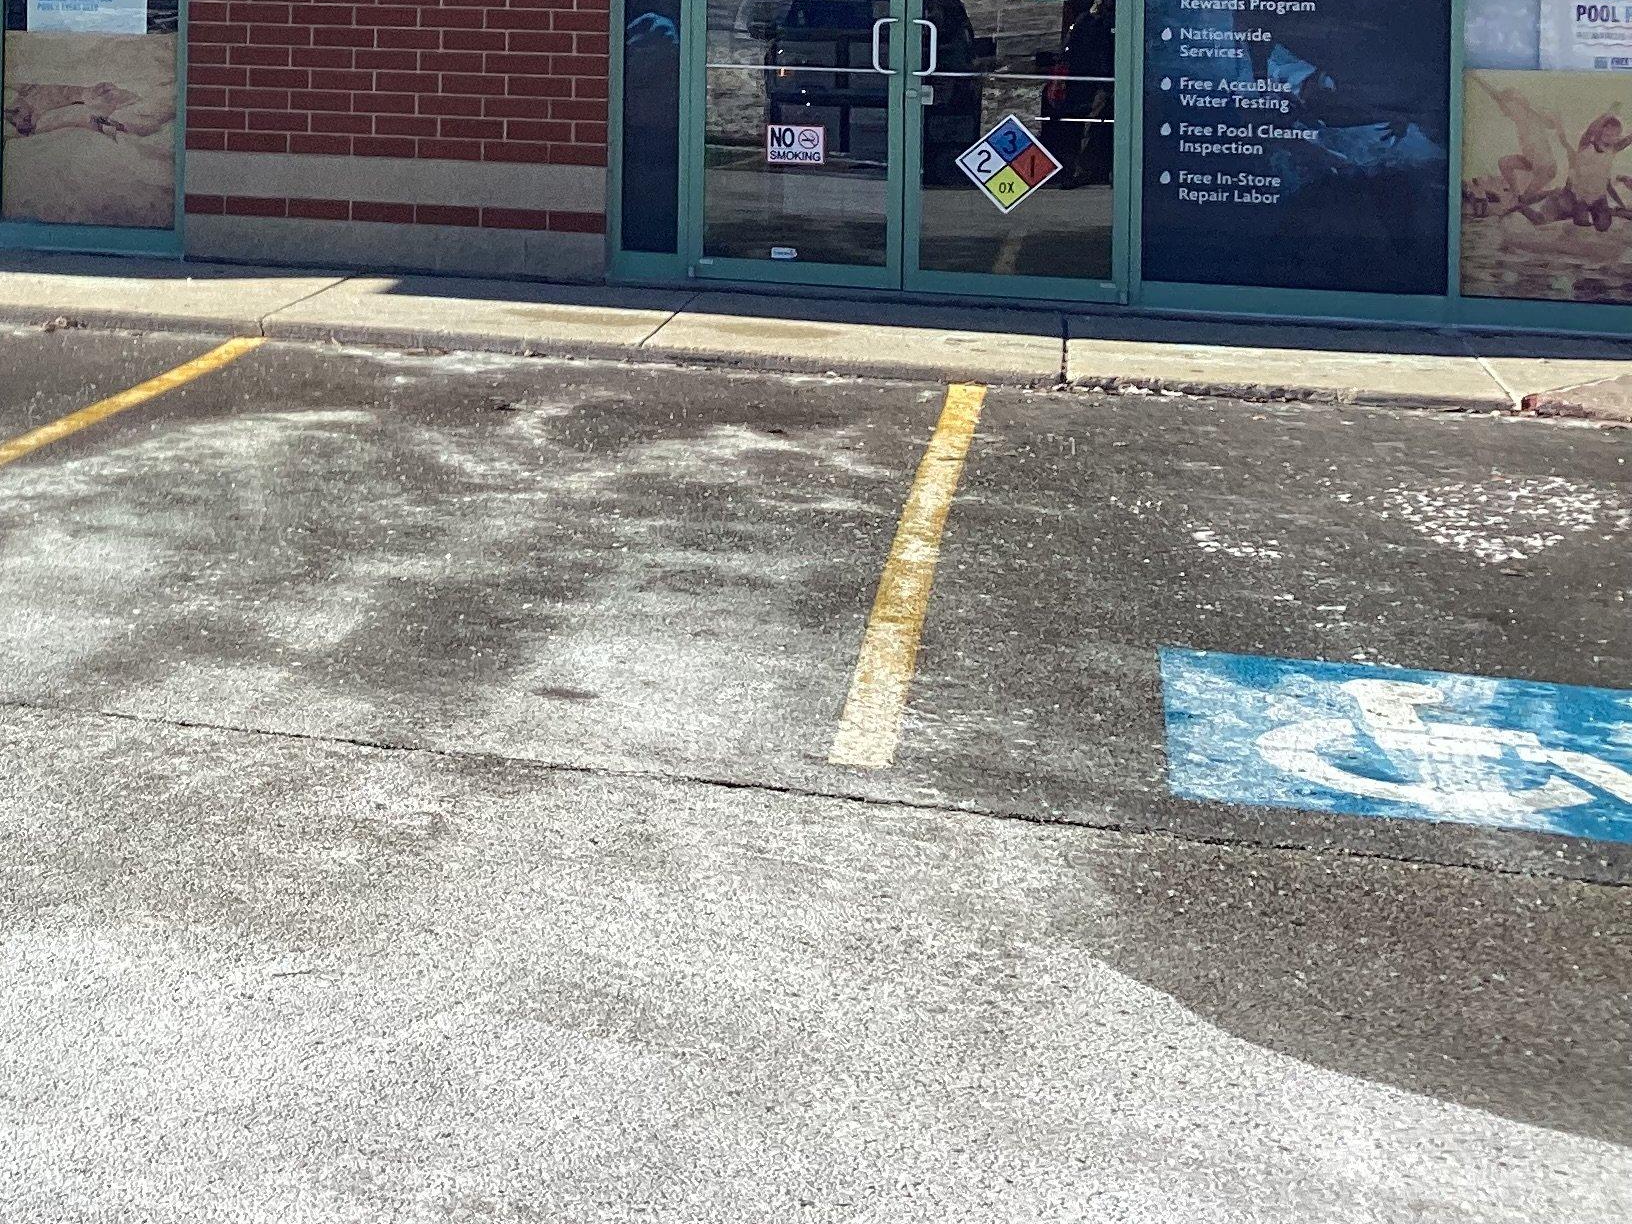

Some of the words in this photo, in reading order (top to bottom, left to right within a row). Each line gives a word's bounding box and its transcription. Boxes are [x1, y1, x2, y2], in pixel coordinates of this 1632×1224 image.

[1576, 4, 1621, 23] POOL
[1180, 27, 1272, 42] Nationwide
[1179, 44, 1245, 58] Services
[1179, 77, 1213, 91] Free
[1217, 78, 1292, 93] AccuBlue
[1179, 94, 1229, 108] Water
[1232, 95, 1290, 114] Testing
[770, 127, 795, 148] NO
[1179, 122, 1213, 136] Free
[1217, 123, 1253, 138] Pool
[1257, 125, 1319, 140] Cleaner
[1001, 130, 1018, 154] 3
[1179, 139, 1264, 157] Inspection
[769, 150, 821, 162] SMOKING
[976, 149, 992, 174] 2
[1029, 154, 1035, 178] 1
[1178, 170, 1212, 185] Free
[1217, 172, 1281, 187] In-Store
[1178, 188, 1230, 205] Repair
[1234, 189, 1281, 204] Labor
